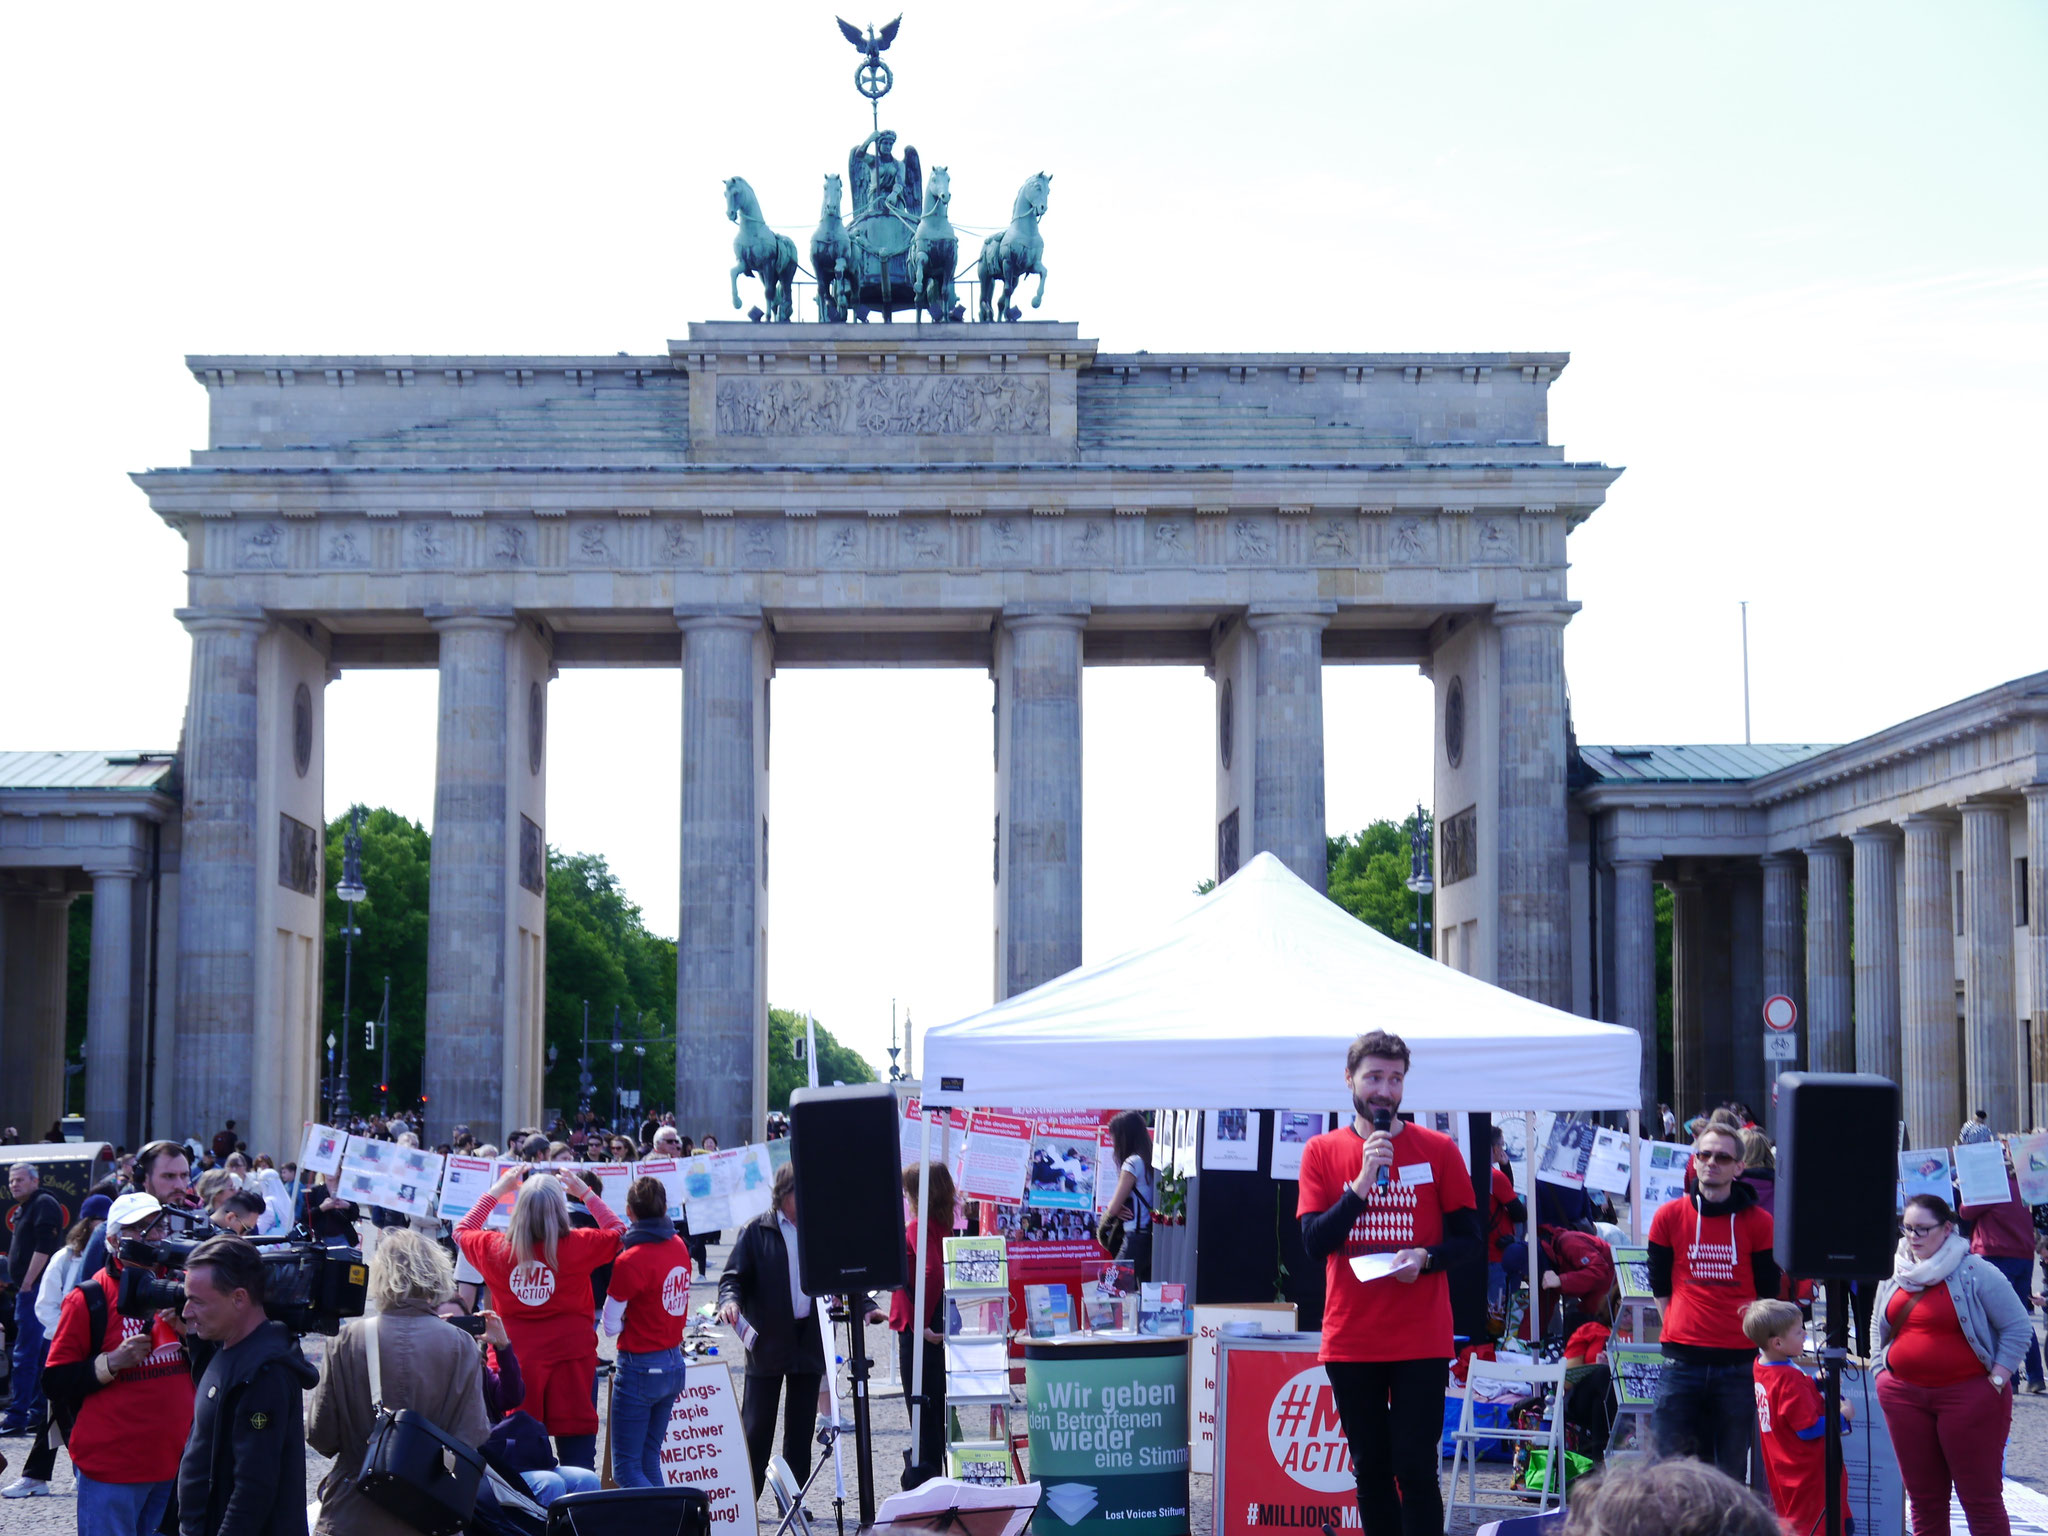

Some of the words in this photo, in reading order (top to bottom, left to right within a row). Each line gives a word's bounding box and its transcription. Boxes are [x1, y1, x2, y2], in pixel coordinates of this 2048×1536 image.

[1059, 1115, 1100, 1125] Gesellschaft
[512, 1266, 550, 1288] #ME
[516, 1286, 553, 1300] ACTION
[1200, 1326, 1220, 1338] Sc
[1101, 1380, 1176, 1413] geben
[1029, 1411, 1050, 1430] den
[1056, 1411, 1162, 1430] Betroffenen
[673, 1424, 724, 1441] schwer
[1049, 1425, 1135, 1451] wieder
[660, 1443, 723, 1464] ME/CFS-
[1095, 1449, 1133, 1468] eine
[667, 1466, 719, 1484] Kranke
[1105, 1509, 1125, 1520] Lost
[1126, 1507, 1157, 1519] Voices
[1158, 1506, 1185, 1518] Stiftung
